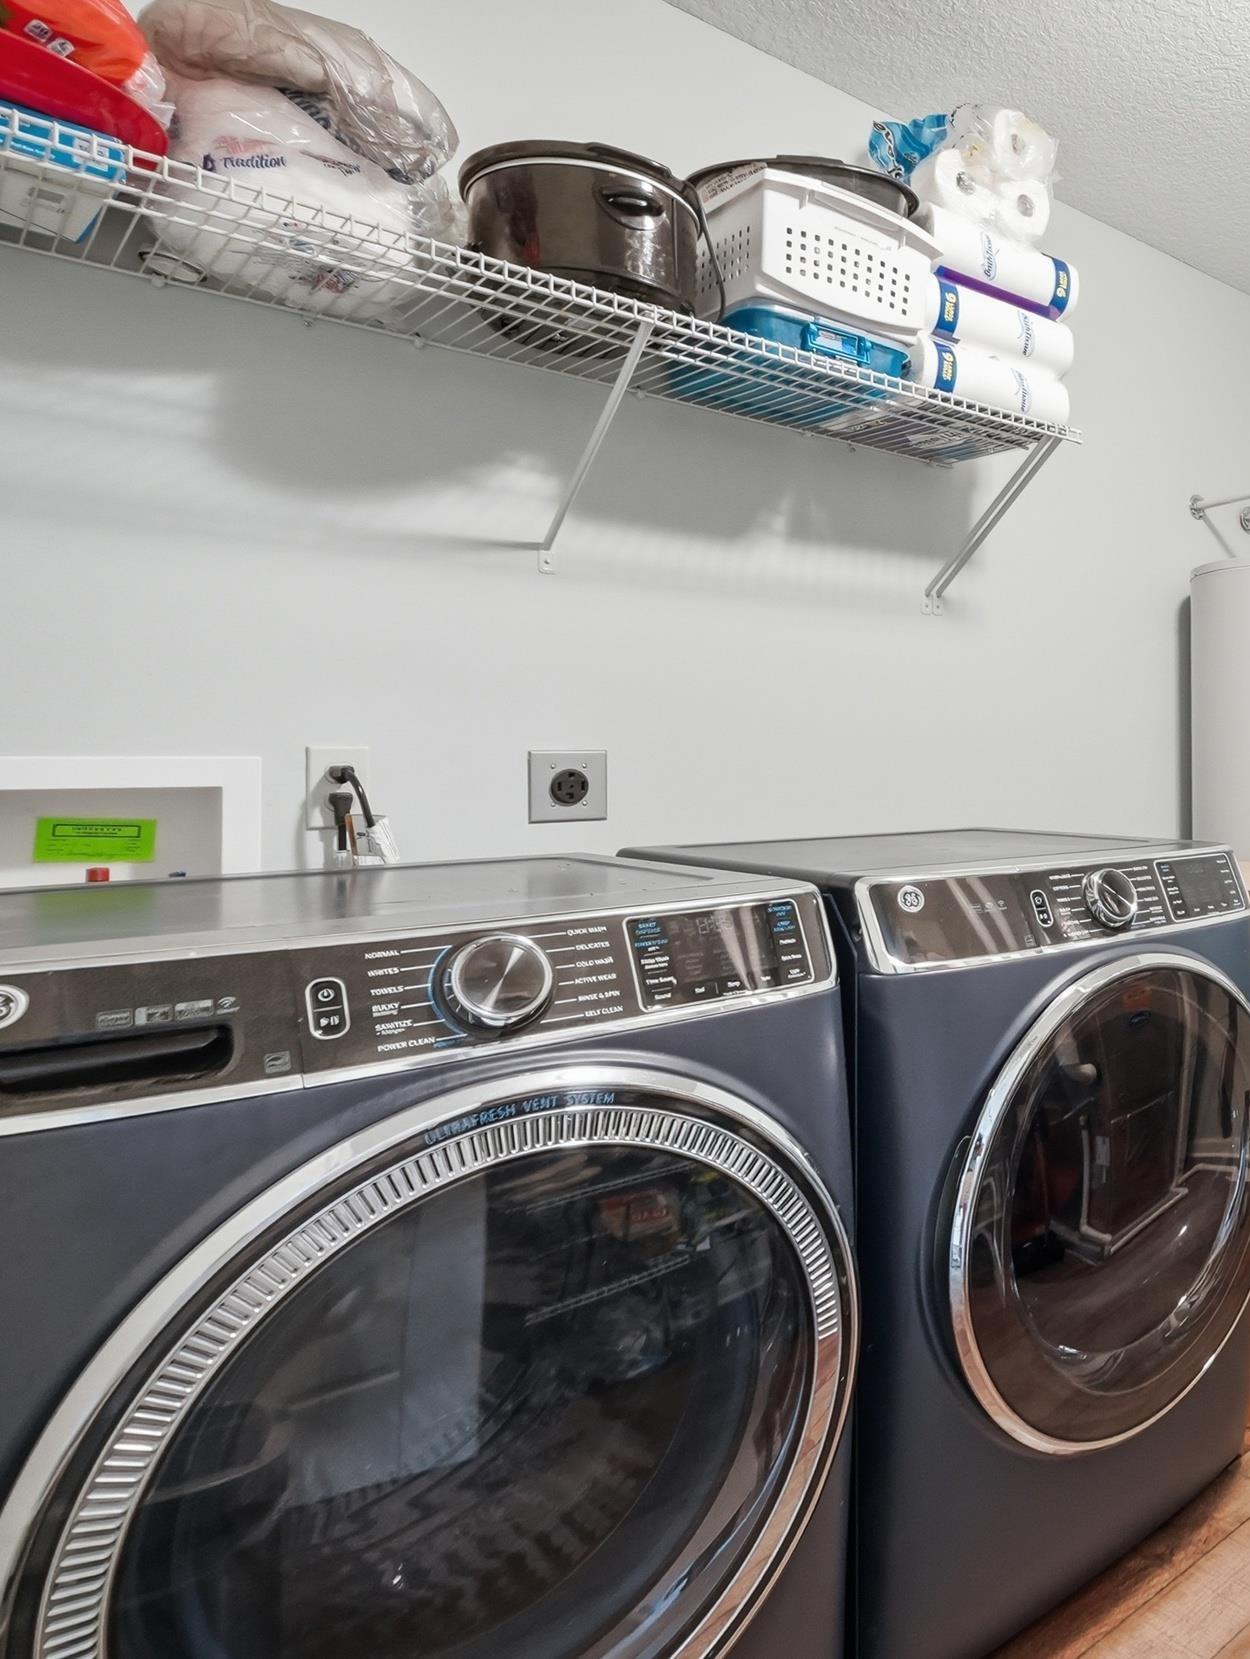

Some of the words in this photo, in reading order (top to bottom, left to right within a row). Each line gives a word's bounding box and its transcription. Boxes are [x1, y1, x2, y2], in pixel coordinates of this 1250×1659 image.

[370, 986, 404, 996] TOWELS
[424, 1103, 516, 1146] ULTRAFRESH
[522, 1095, 557, 1113] VENT
[566, 1092, 615, 1105] SYSTEM
